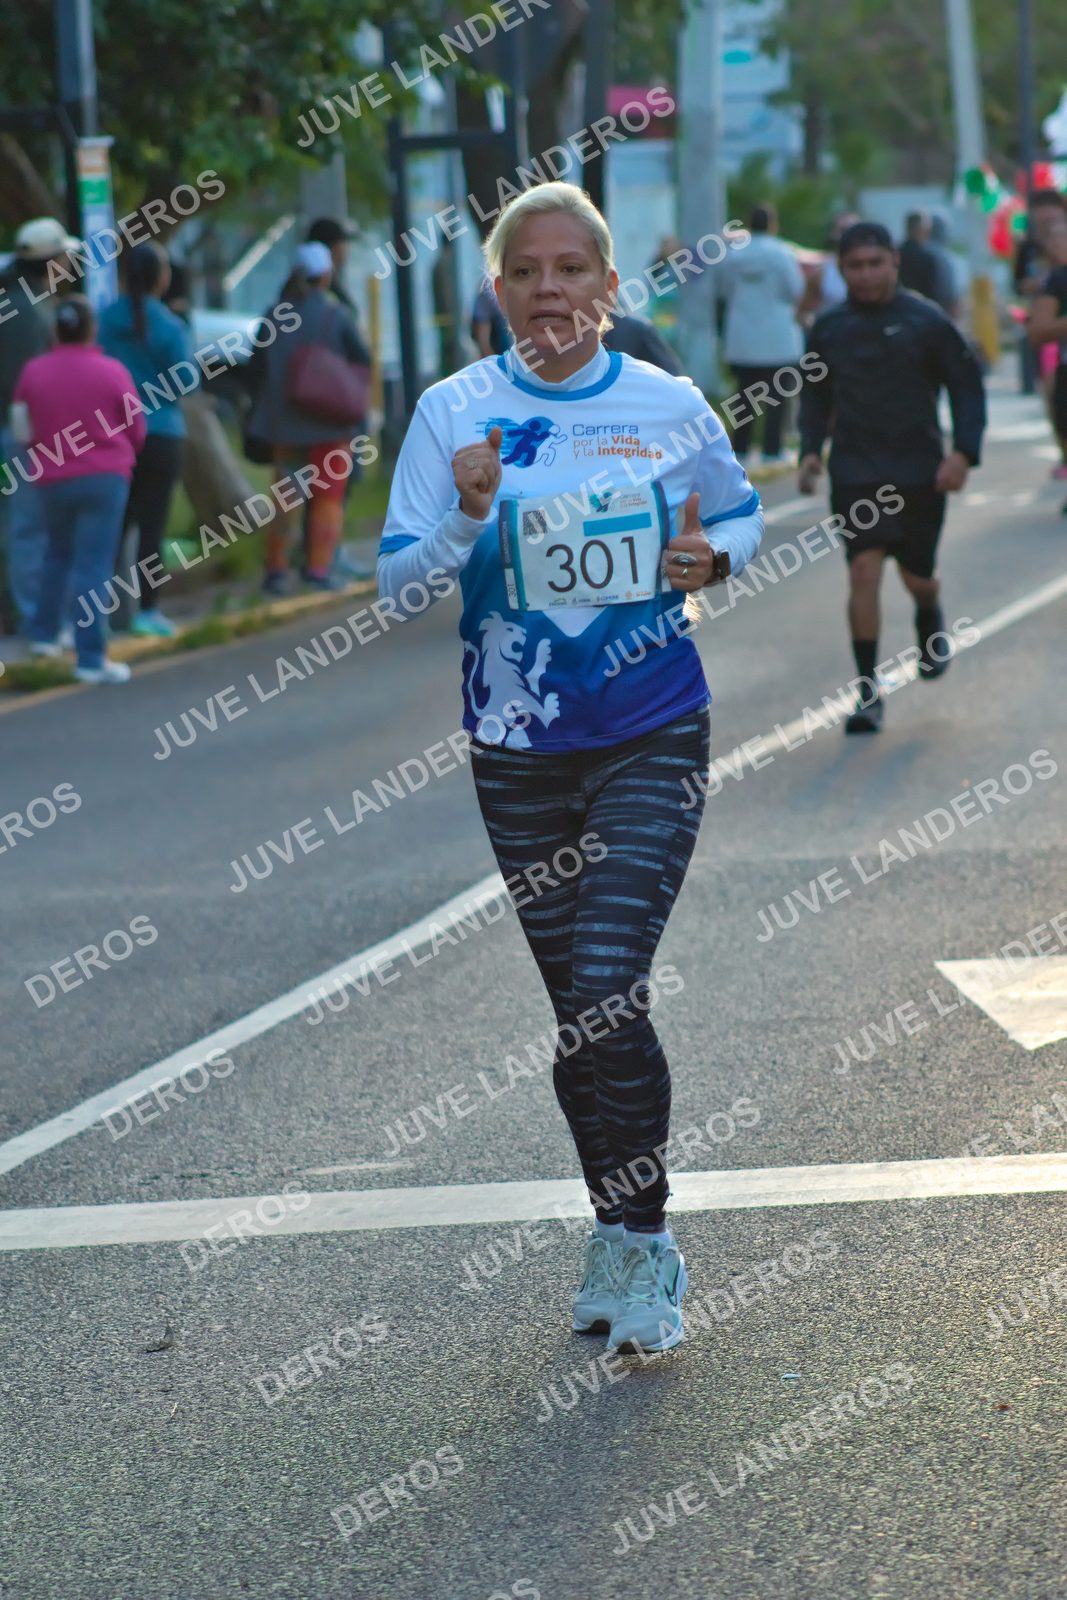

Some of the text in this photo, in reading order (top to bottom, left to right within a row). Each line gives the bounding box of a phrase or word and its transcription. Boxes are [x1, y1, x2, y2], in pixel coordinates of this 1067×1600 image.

[572, 424, 639, 437] Carrera
[573, 435, 641, 449] por la Vida
[573, 449, 580, 460] y
[583, 447, 594, 457] la
[546, 536, 639, 593] 301
